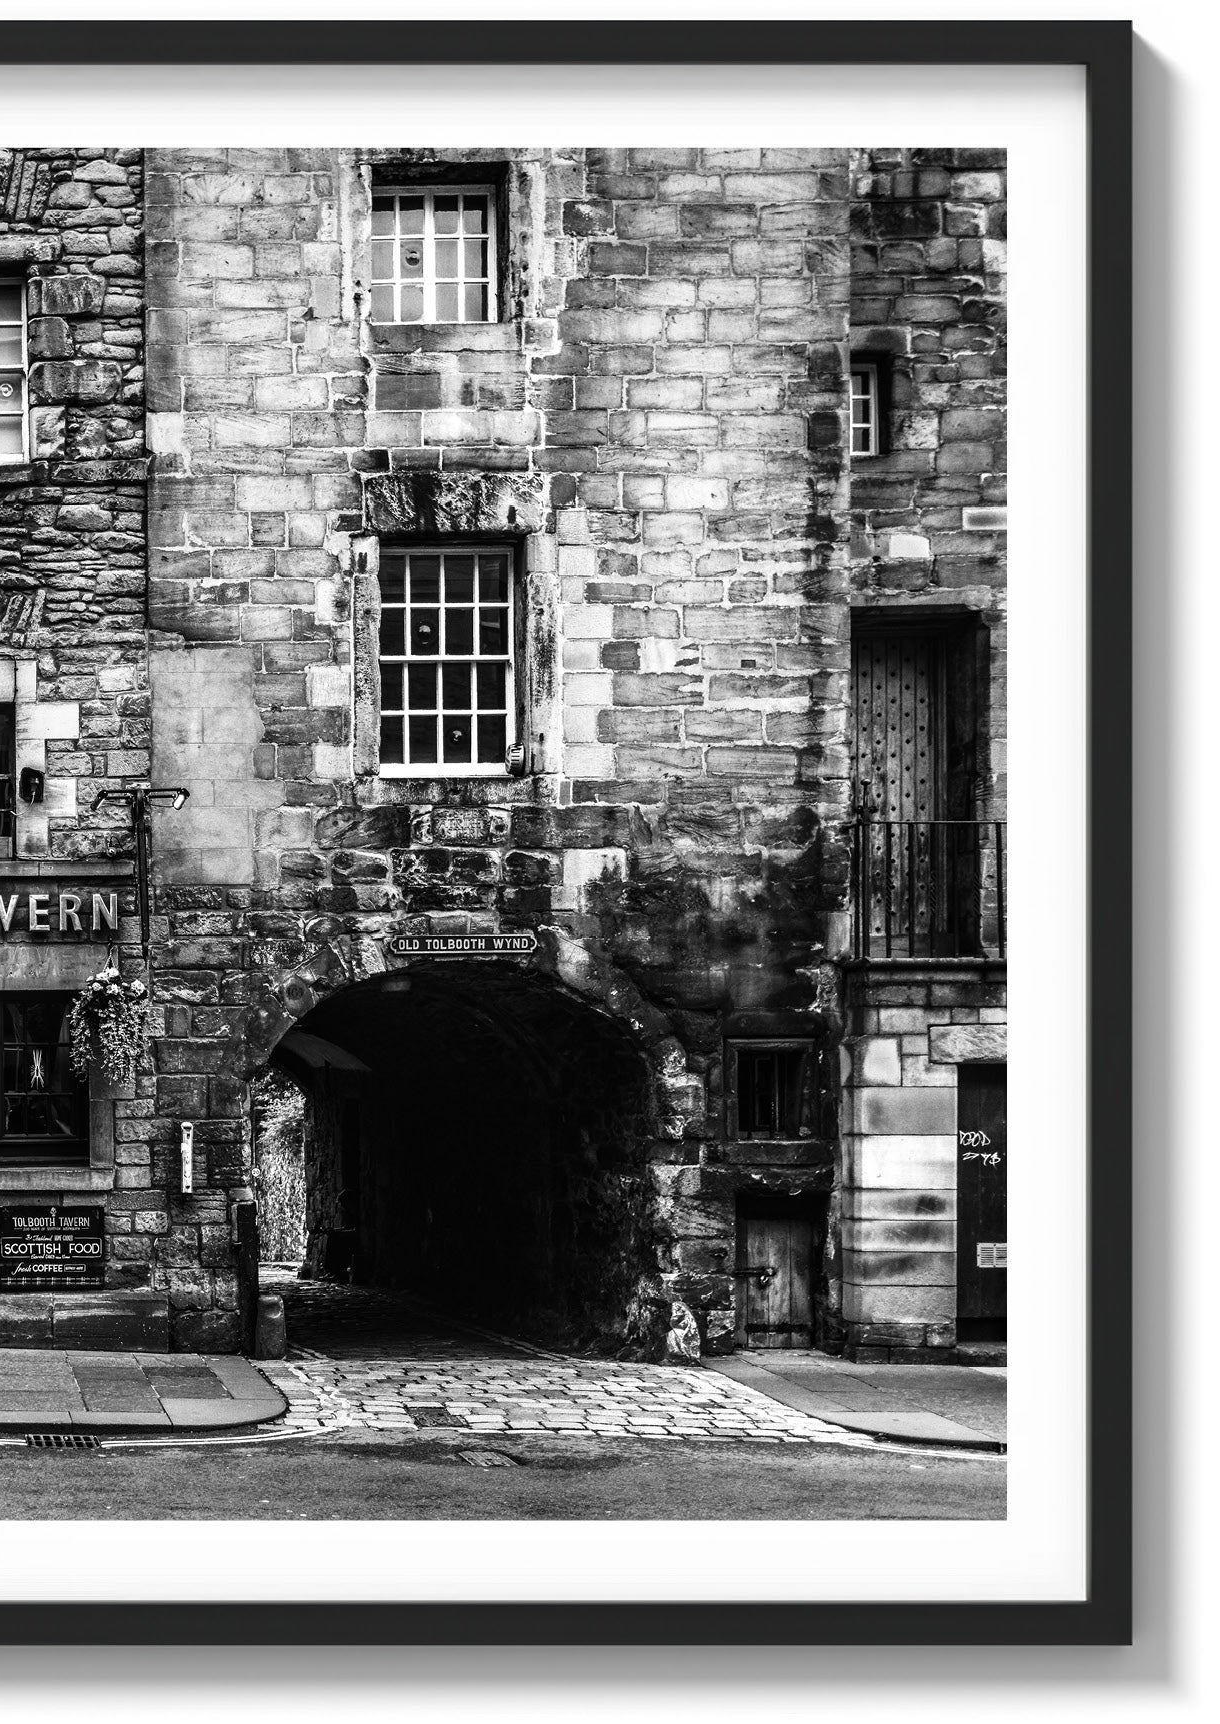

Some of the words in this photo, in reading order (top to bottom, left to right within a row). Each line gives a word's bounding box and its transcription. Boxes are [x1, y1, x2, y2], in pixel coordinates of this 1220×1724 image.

[398, 939, 420, 950] OLD
[425, 938, 486, 950] TOLBOOTH
[493, 937, 529, 949] WYND
[12, 1216, 56, 1228] TOLBOOTH
[59, 1216, 90, 1227] TAVERN
[4, 1243, 61, 1254] SCOTTISH
[69, 1243, 100, 1254] FOOD
[32, 1264, 63, 1273] COFFEE
